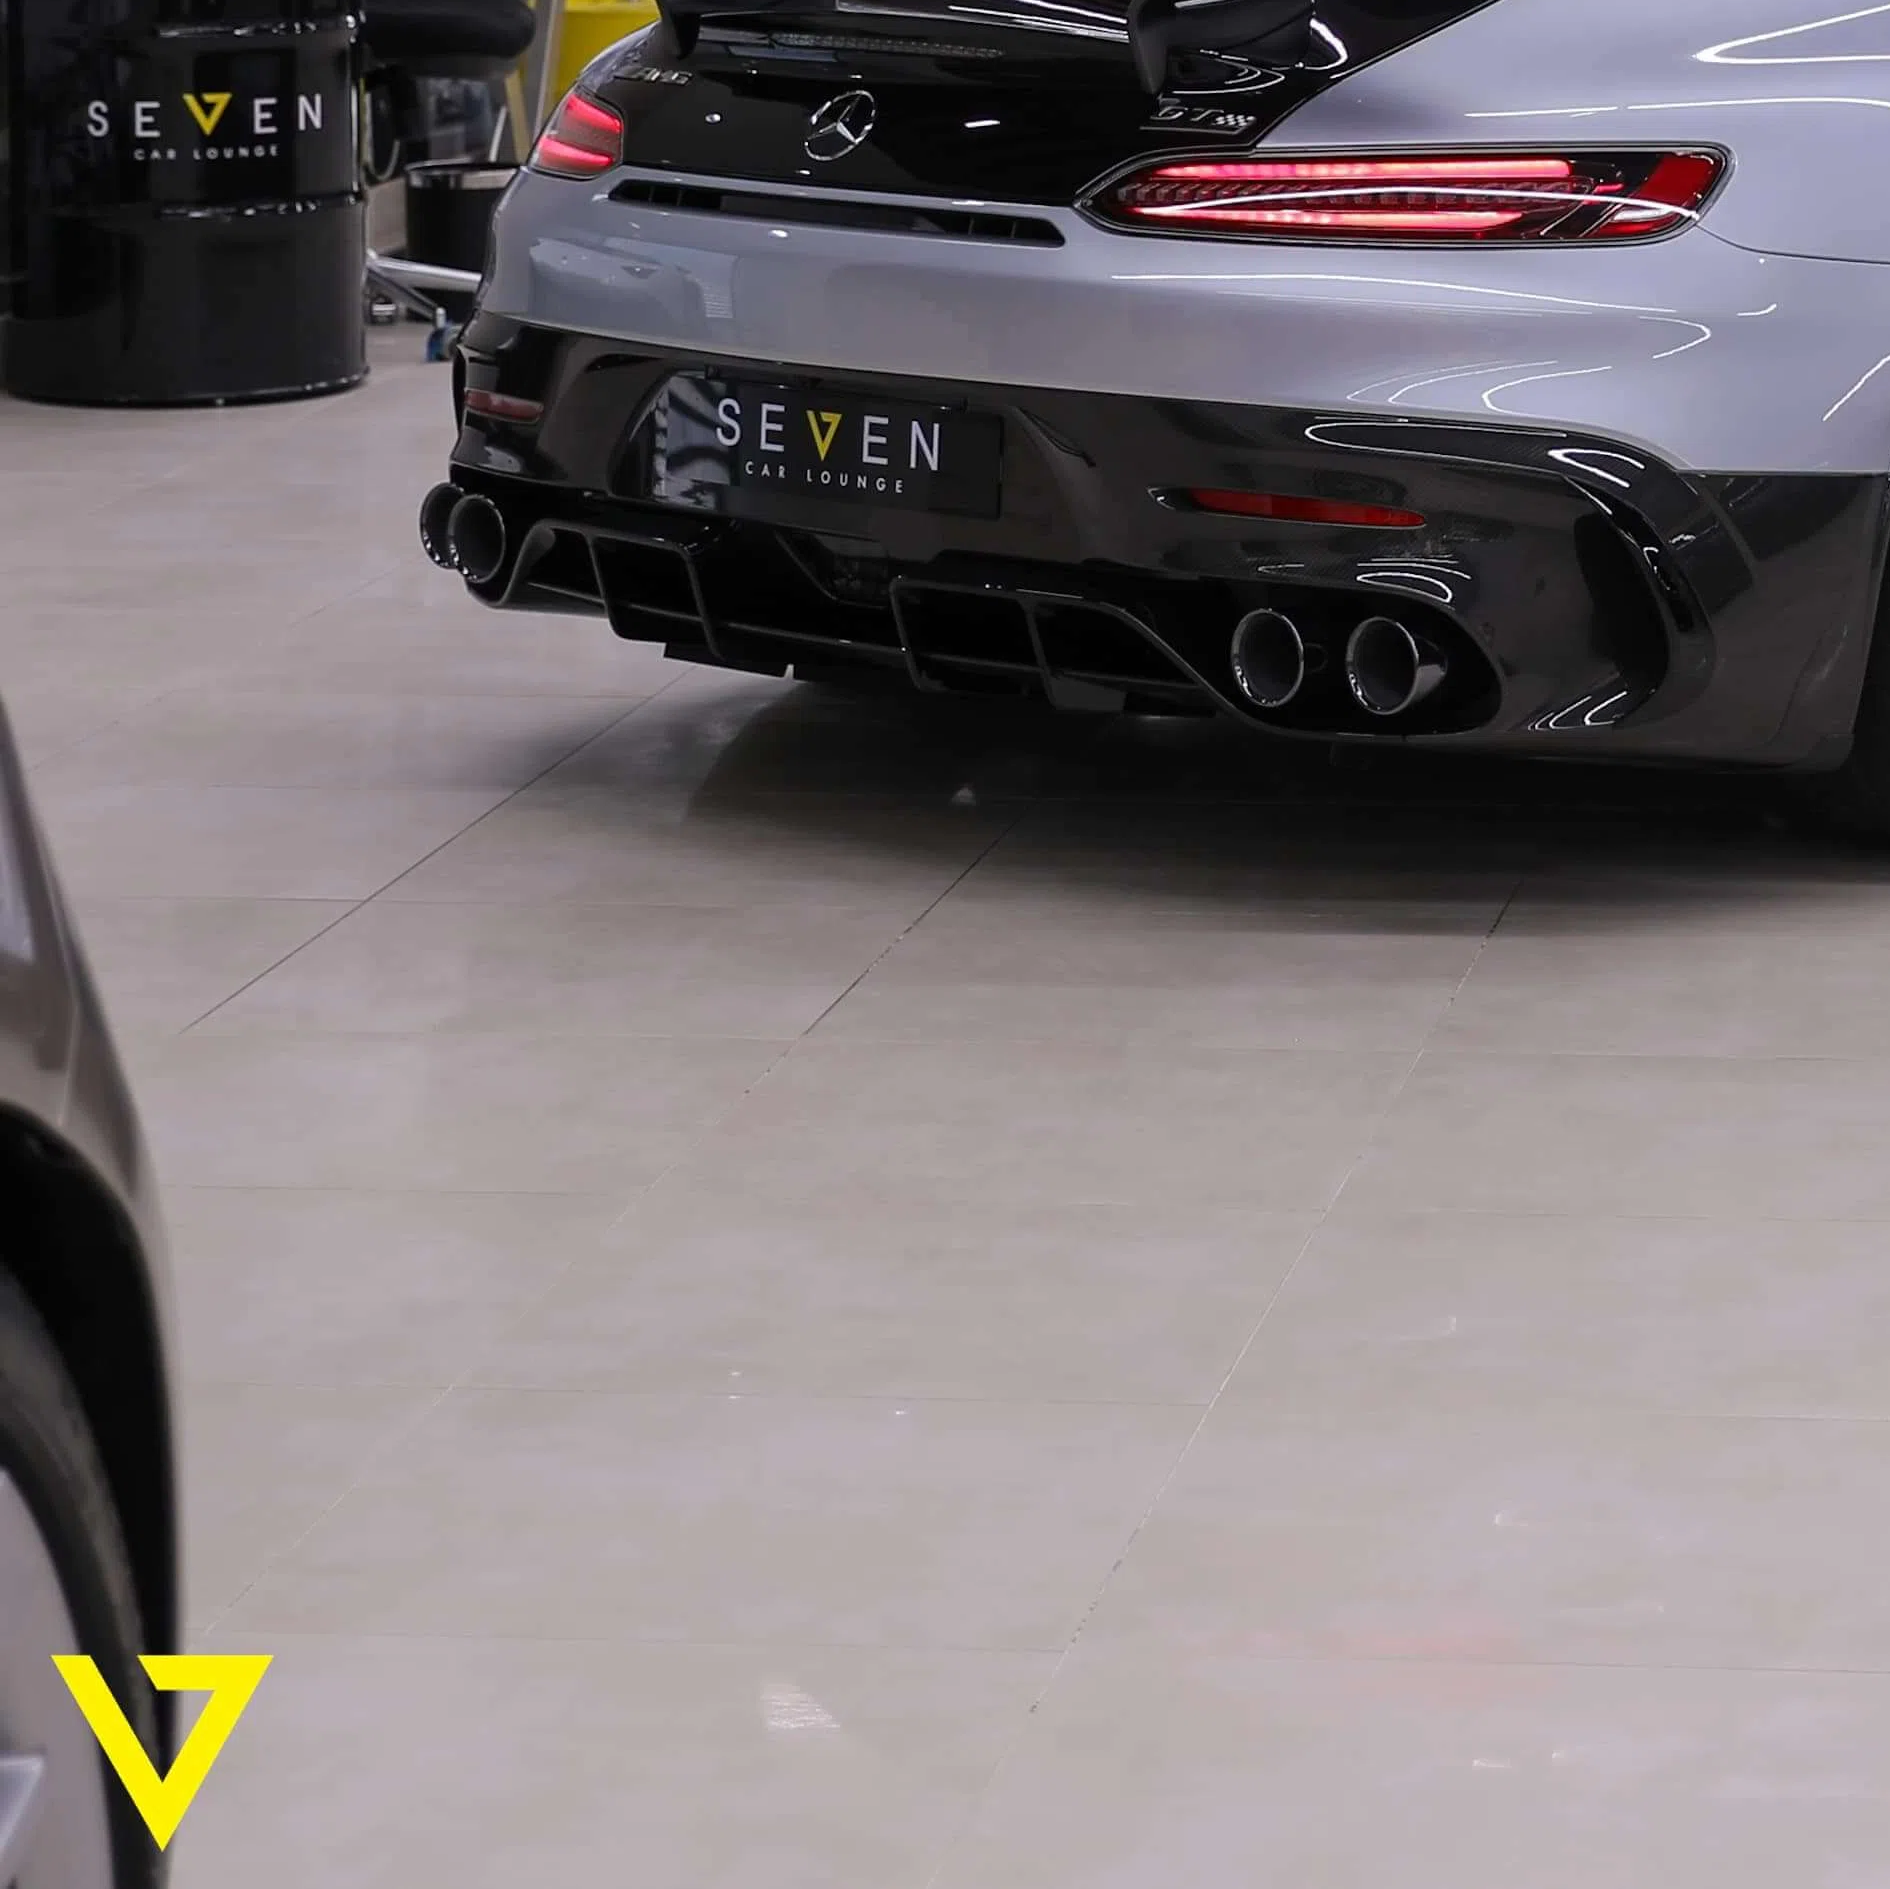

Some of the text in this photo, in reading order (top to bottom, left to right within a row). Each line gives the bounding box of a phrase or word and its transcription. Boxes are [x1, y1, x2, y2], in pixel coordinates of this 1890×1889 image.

[87, 93, 322, 138] SEVEN
[193, 144, 279, 160] LOUNGE
[716, 398, 940, 471] SEVEN
[745, 461, 904, 494] CAR LOUNGE
